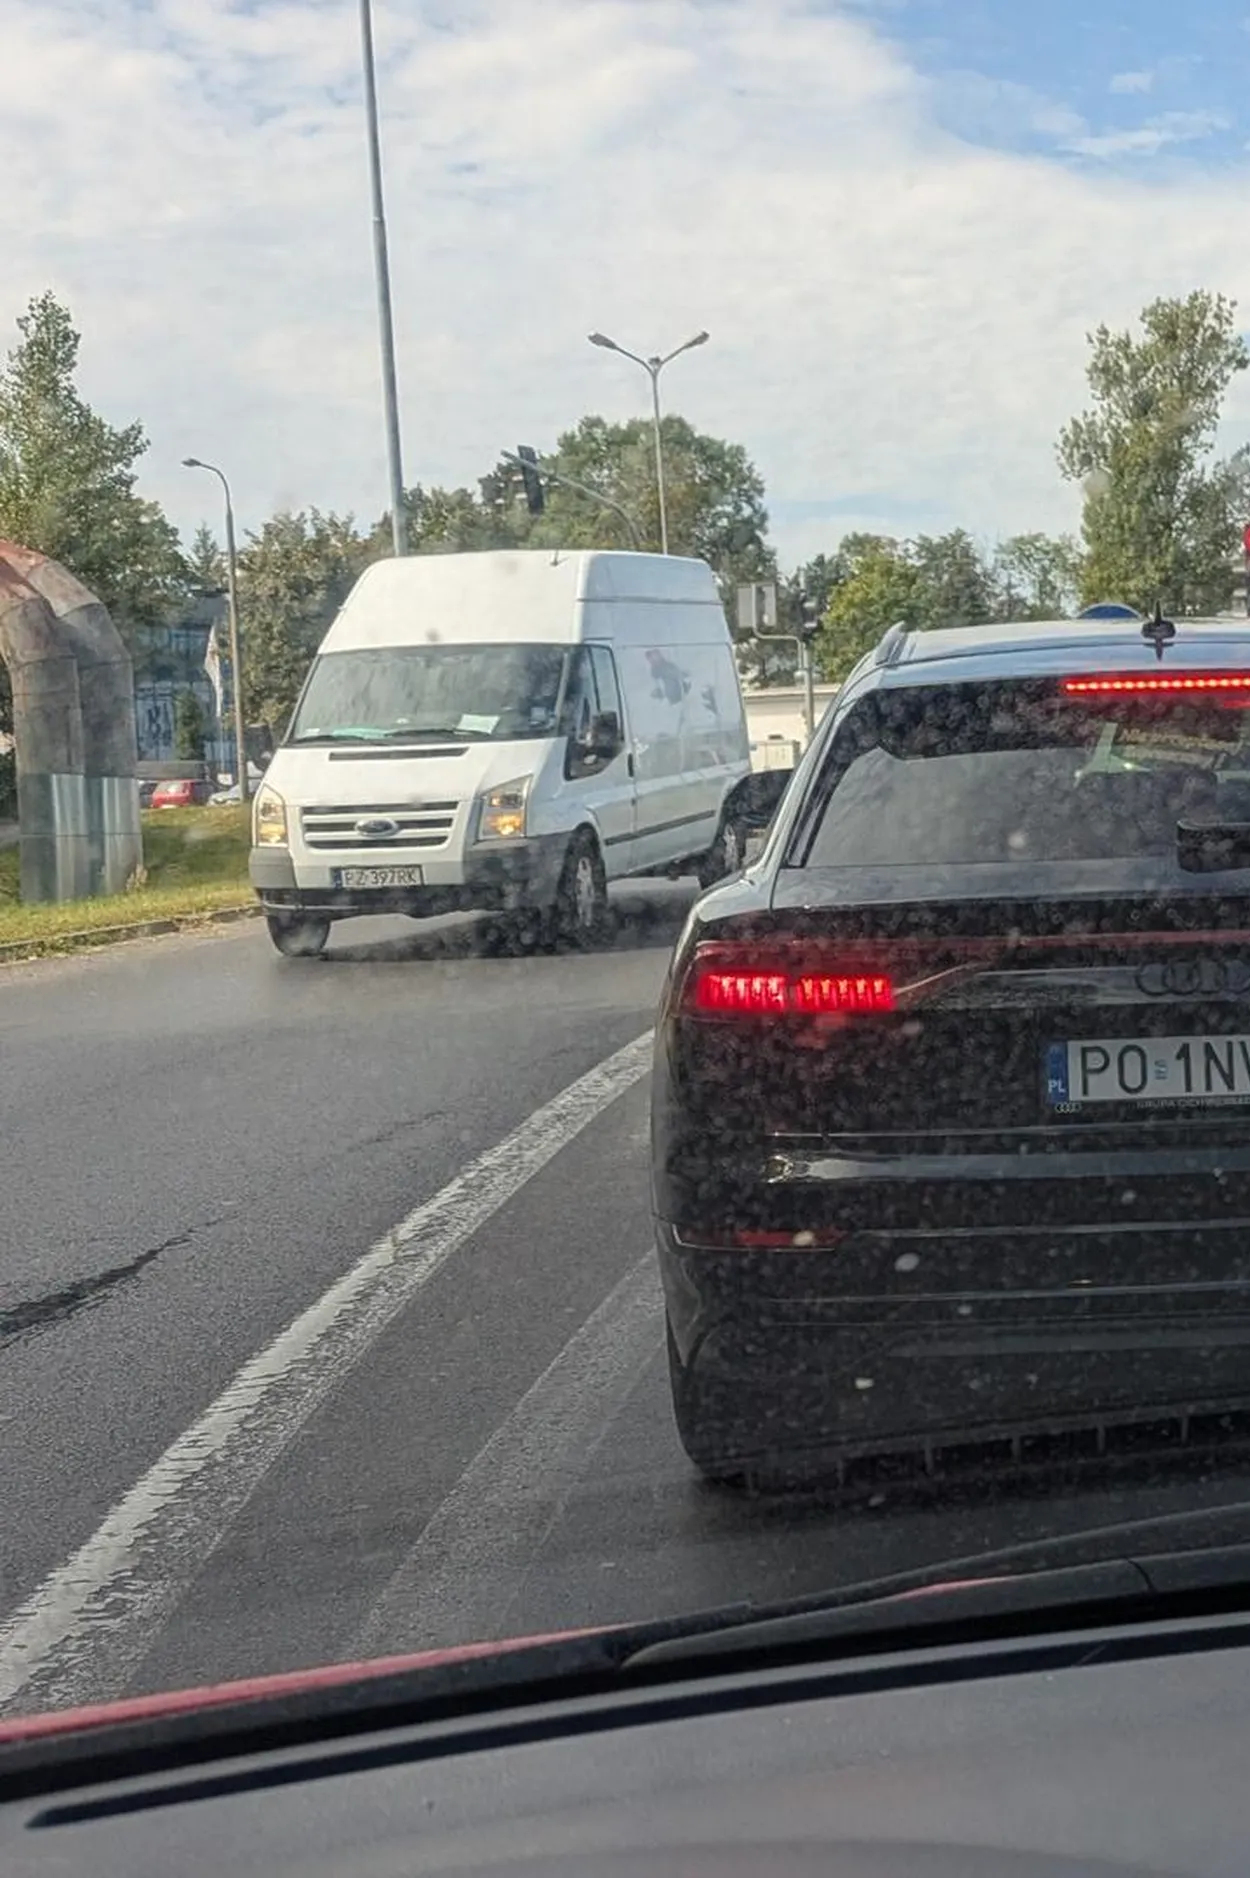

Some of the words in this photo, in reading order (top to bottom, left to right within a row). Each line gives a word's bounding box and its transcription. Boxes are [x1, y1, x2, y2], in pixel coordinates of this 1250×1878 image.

[370, 868, 417, 885] 397RK
[1080, 1044, 1148, 1097] PO
[1048, 1080, 1066, 1094] PL
